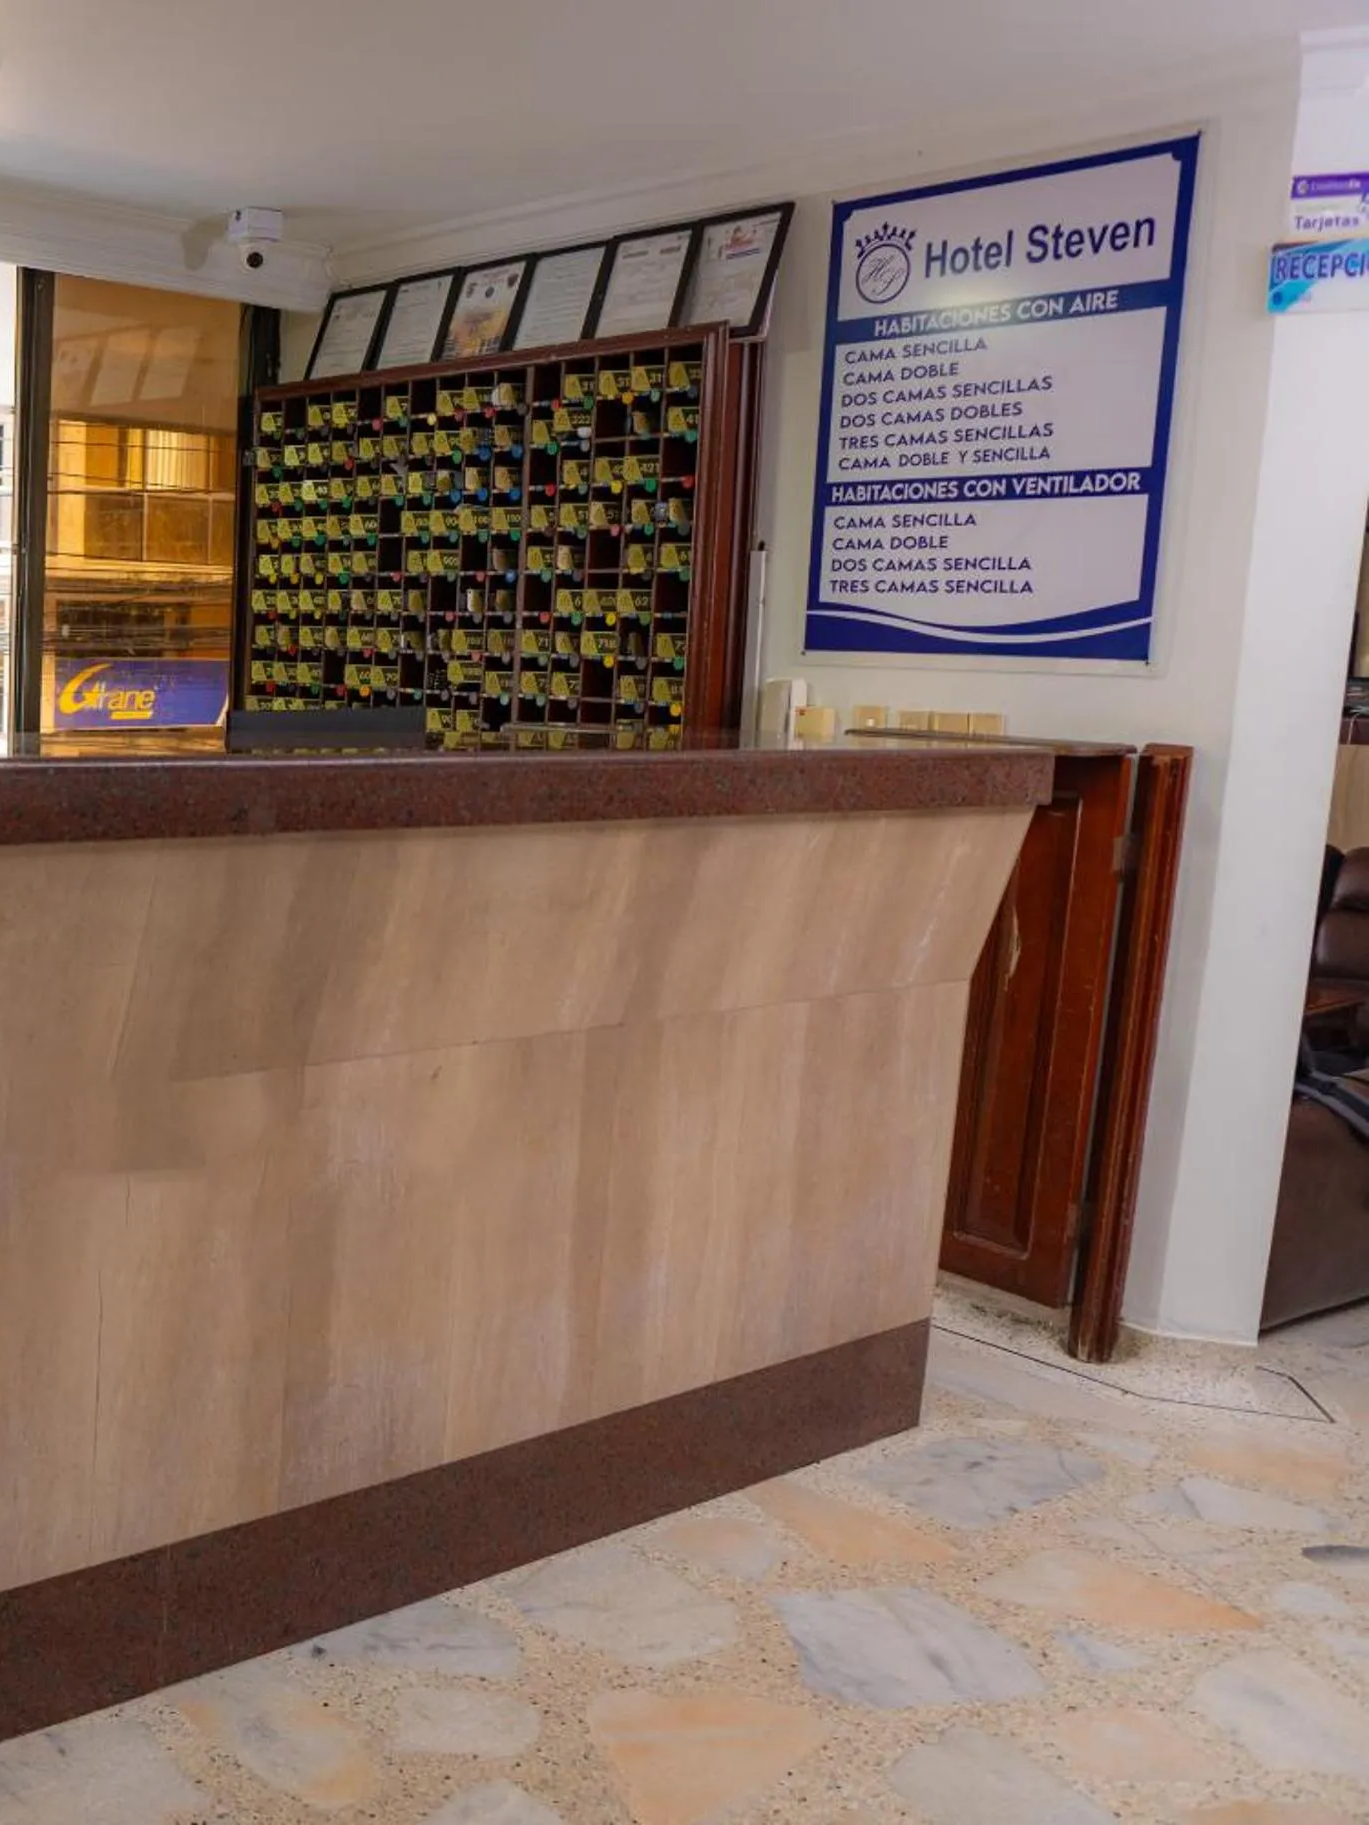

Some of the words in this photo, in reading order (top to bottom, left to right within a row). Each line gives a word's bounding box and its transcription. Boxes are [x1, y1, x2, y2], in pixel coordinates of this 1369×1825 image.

[1295, 215, 1359, 232] Tarjetas
[925, 230, 1013, 278] Hotel
[1026, 216, 1155, 264] Steven
[1276, 252, 1369, 281] RECEPCI
[874, 304, 1012, 337] HABITACIONES
[1017, 298, 1064, 319] CON
[1069, 290, 1120, 314] AIRE
[845, 349, 896, 364] CAMA
[902, 337, 988, 358] SENCILLA
[843, 370, 894, 386] CAMA
[901, 363, 959, 380] DOBLE
[841, 392, 877, 408] DOS
[882, 386, 947, 404] CAMAS
[952, 376, 1053, 398] SENCILLAS
[840, 413, 875, 429] DOS
[881, 408, 945, 426] CAMAS
[950, 401, 1023, 421] DOBLES
[839, 435, 879, 450] TRES
[885, 430, 949, 447] CAMAS
[953, 423, 1054, 443] SENCILLAS
[839, 457, 891, 471] CAMA
[898, 452, 949, 467] DOBLE
[959, 450, 968, 464] Y
[972, 446, 1051, 463] SENCILLA
[831, 480, 958, 502] HABITACIONES
[963, 479, 1006, 498] CON
[1012, 471, 1141, 495] VENTILADOR
[834, 515, 886, 530] CAMA
[892, 513, 977, 528] SENCILLA
[832, 537, 885, 551] CAMA
[890, 536, 949, 549] DOBLE
[831, 558, 868, 572] DOS
[872, 557, 937, 571] CAMAS
[942, 556, 1032, 571] SENCILLA
[829, 579, 869, 593] TRES
[874, 579, 939, 594] CAMAS
[945, 579, 1034, 594] SENCILLA
